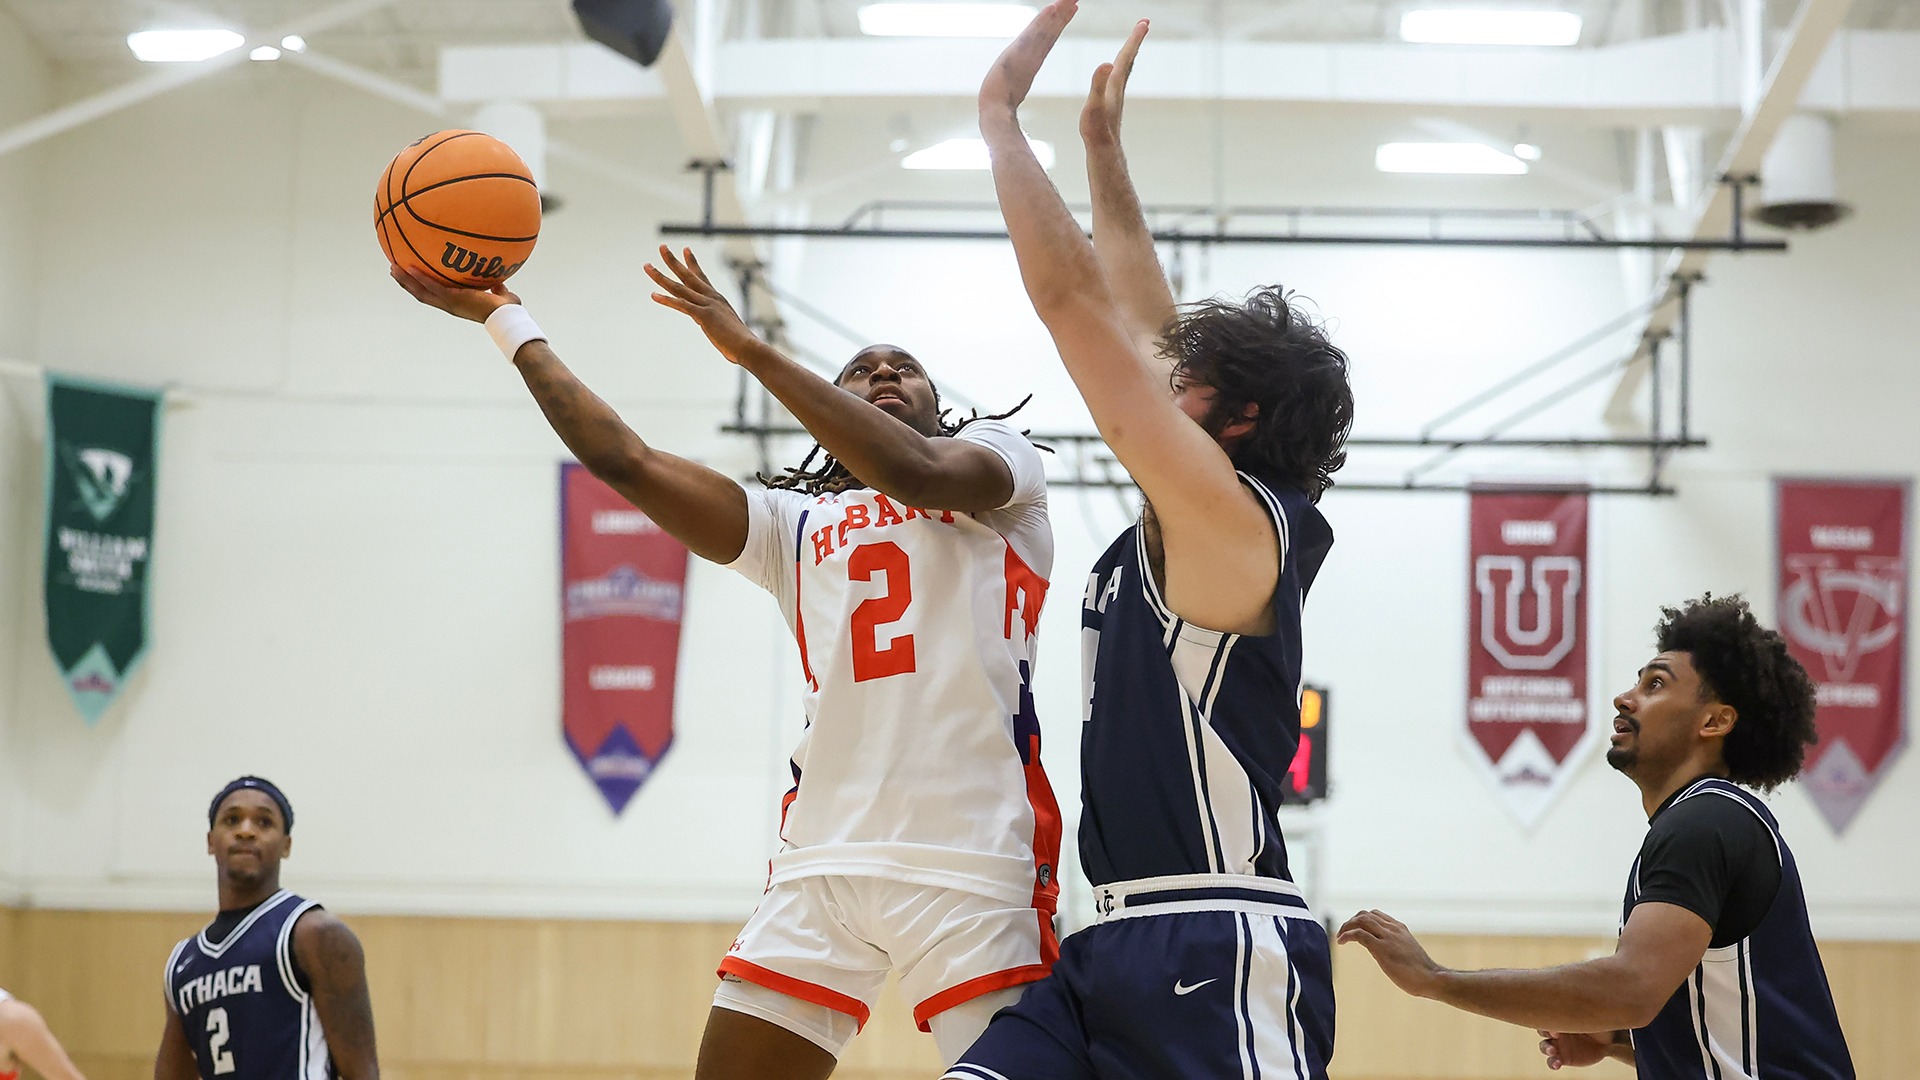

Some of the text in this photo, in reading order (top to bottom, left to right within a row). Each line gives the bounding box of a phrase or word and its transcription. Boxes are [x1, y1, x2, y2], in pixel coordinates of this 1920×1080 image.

[441, 241, 526, 278] Wilso
[848, 541, 916, 682] 2
[1476, 555, 1581, 670] U
[179, 965, 263, 1015] ITHACA
[206, 1007, 235, 1075] 2
